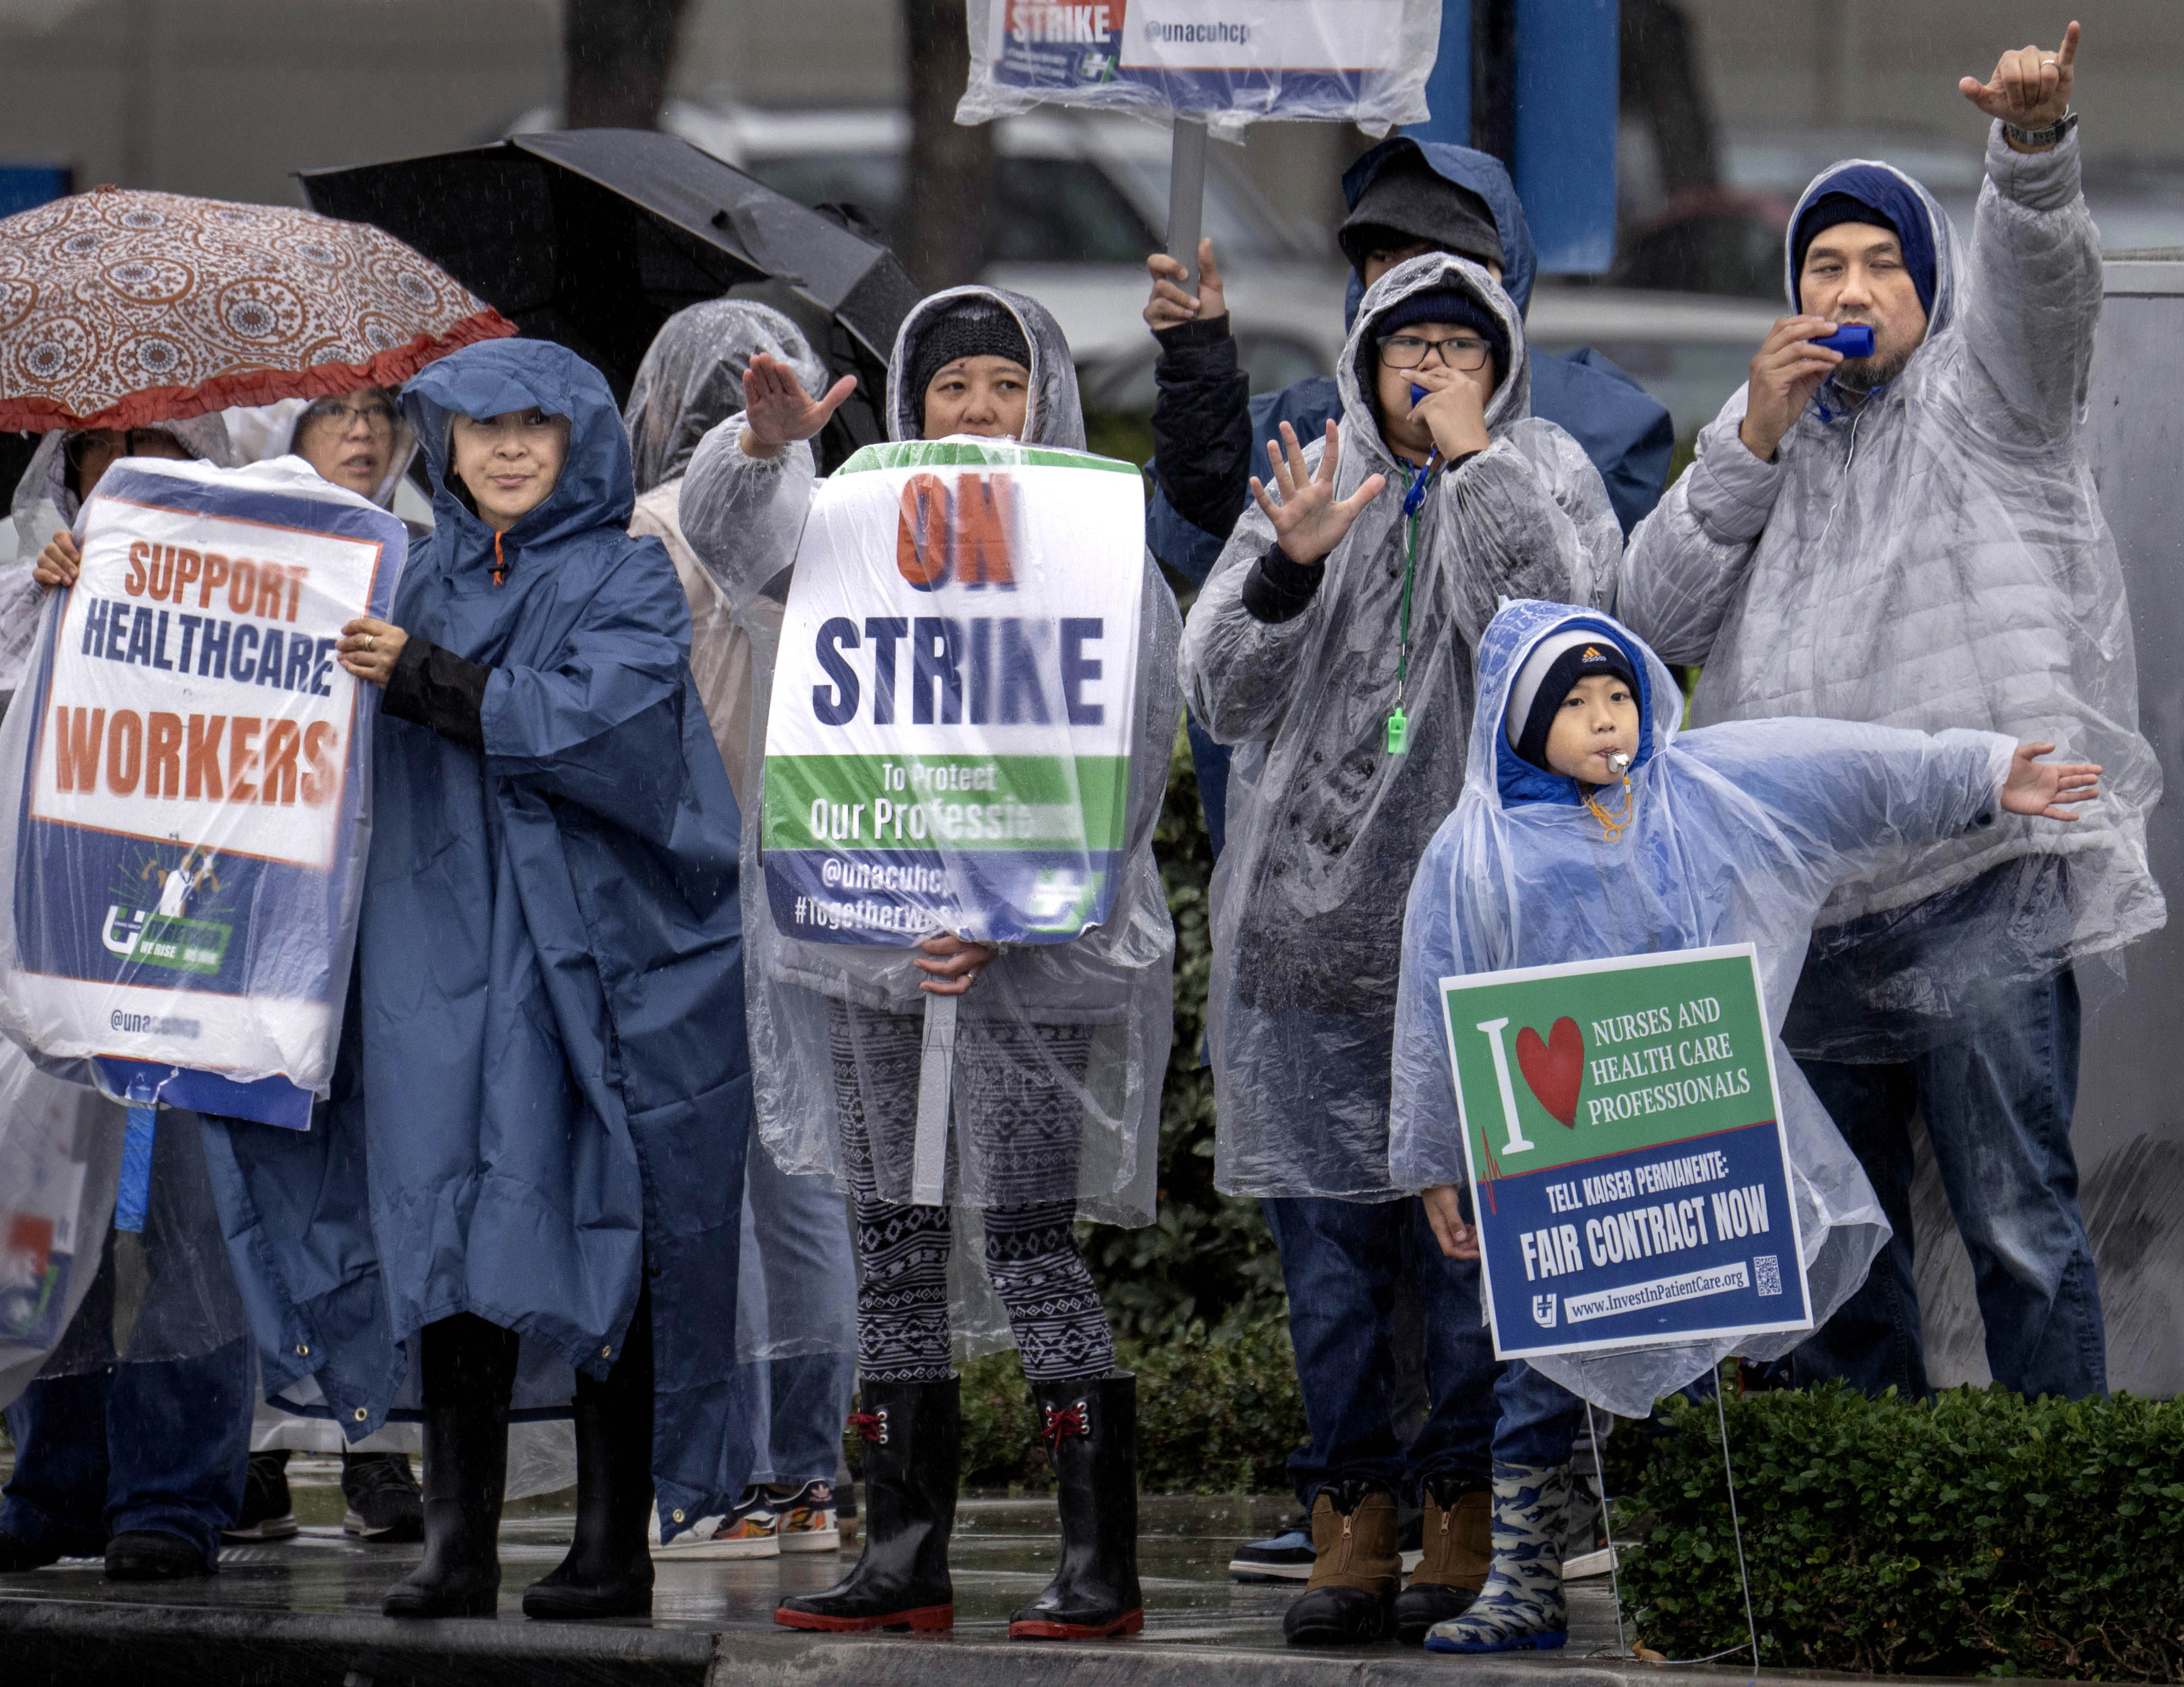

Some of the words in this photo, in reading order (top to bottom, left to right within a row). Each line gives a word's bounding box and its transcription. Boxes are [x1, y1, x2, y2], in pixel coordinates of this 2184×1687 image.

[1012, 5, 1111, 43] STRIKE
[897, 473, 1019, 592] ON
[124, 540, 309, 622] SUPPORT
[81, 597, 338, 697] HEALTHCARE
[812, 616, 1104, 726] STRIKE
[56, 706, 339, 808] WORKERS
[883, 763, 905, 791] To
[912, 764, 996, 792] Protect
[811, 798, 865, 840] Our
[153, 942, 177, 958] RISE
[1592, 1006, 1672, 1046] NURSES
[1678, 996, 1721, 1027] AND
[1476, 1017, 1535, 1155] I
[1590, 1045, 1676, 1085] HEALTH
[1678, 1032, 1733, 1066] CARE
[1587, 1067, 1750, 1125] PROFESSIONALS
[1546, 1181, 1582, 1213] TELL
[1582, 1170, 1634, 1205] KAISER
[1635, 1150, 1729, 1195] PERMANENTE:
[1520, 1223, 1583, 1281] FAIR
[1586, 1196, 1708, 1267] CONTRACT
[1711, 1184, 1770, 1242] NOW
[1572, 1271, 1743, 1318] www.InvestInPatientCare.org
